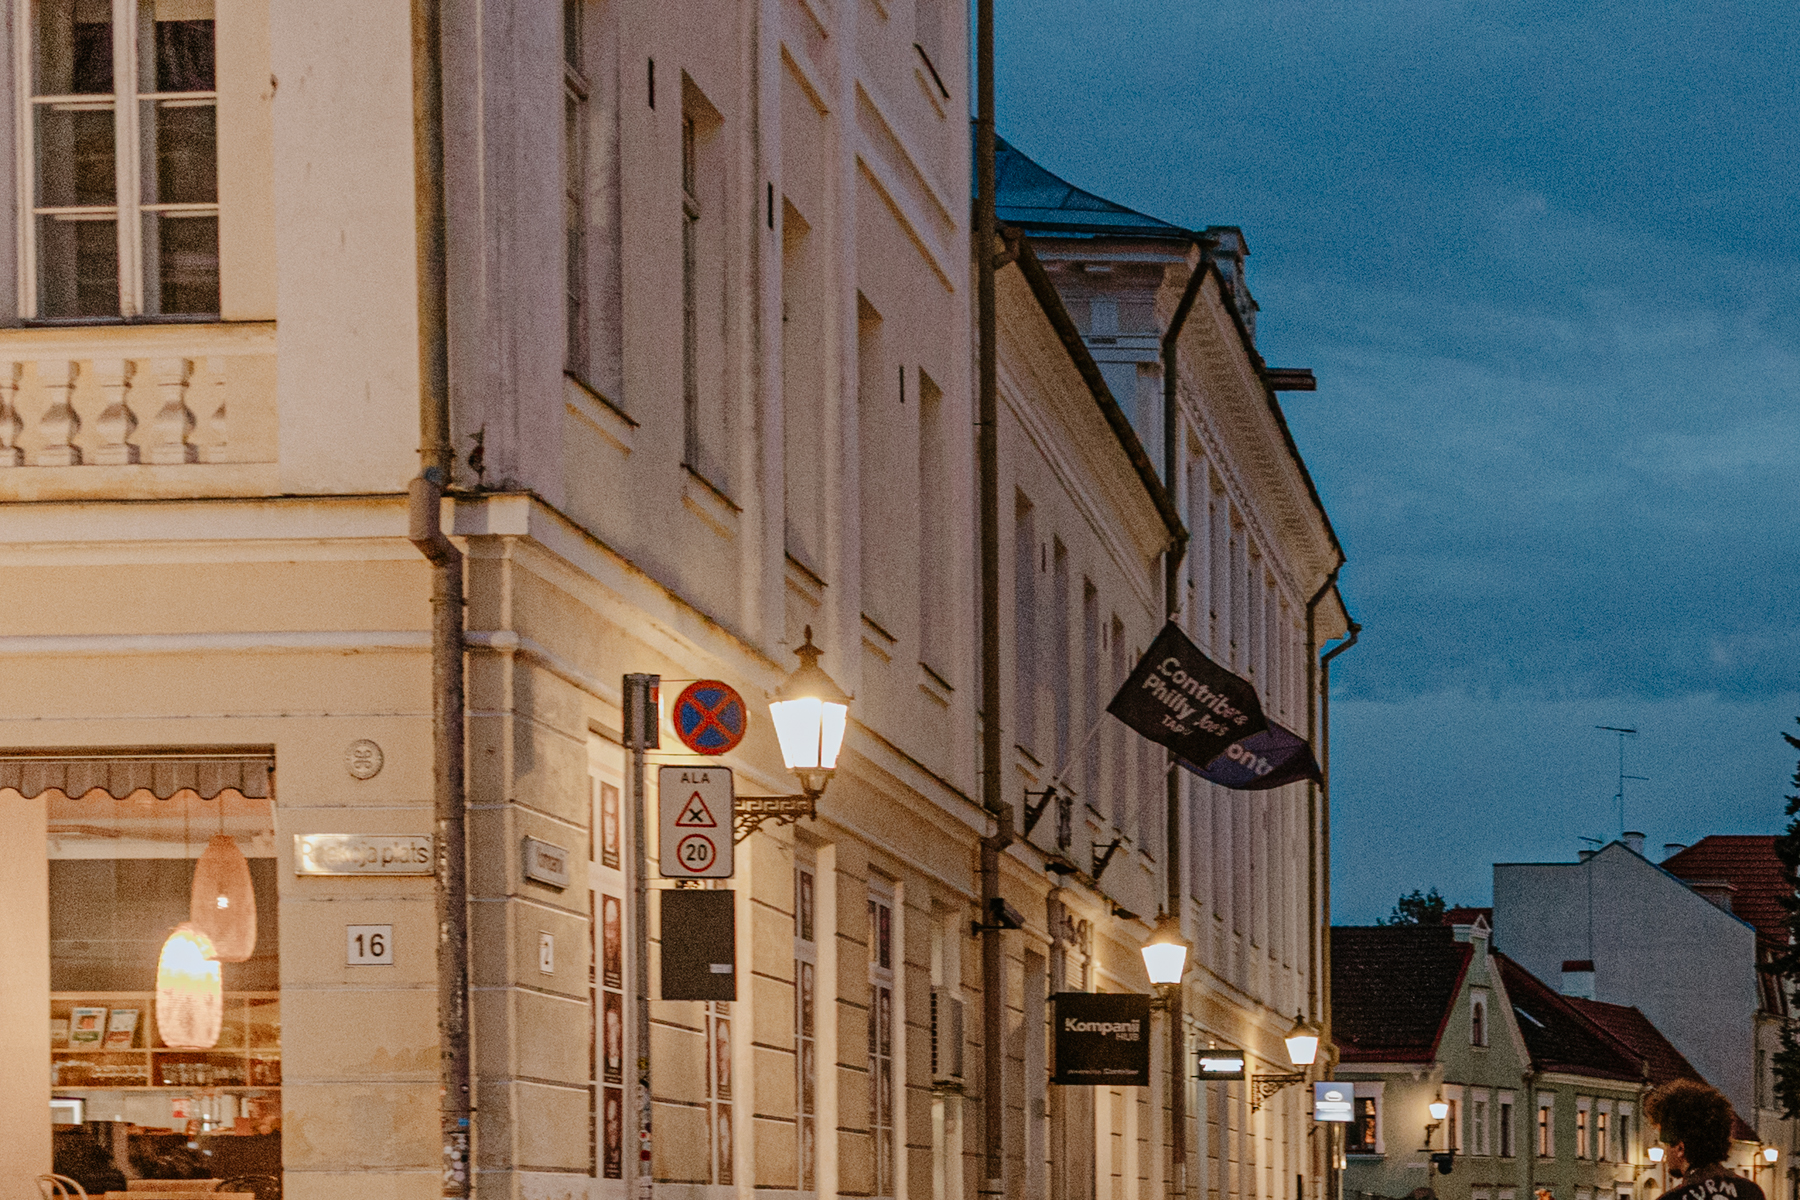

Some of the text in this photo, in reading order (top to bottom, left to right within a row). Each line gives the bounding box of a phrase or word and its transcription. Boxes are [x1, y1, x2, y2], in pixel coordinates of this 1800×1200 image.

[1142, 672, 1199, 721] Philly
[680, 772, 711, 784] ALA
[685, 843, 708, 862] 20
[354, 933, 386, 958] 16
[1064, 1017, 1141, 1037] Kompanii
